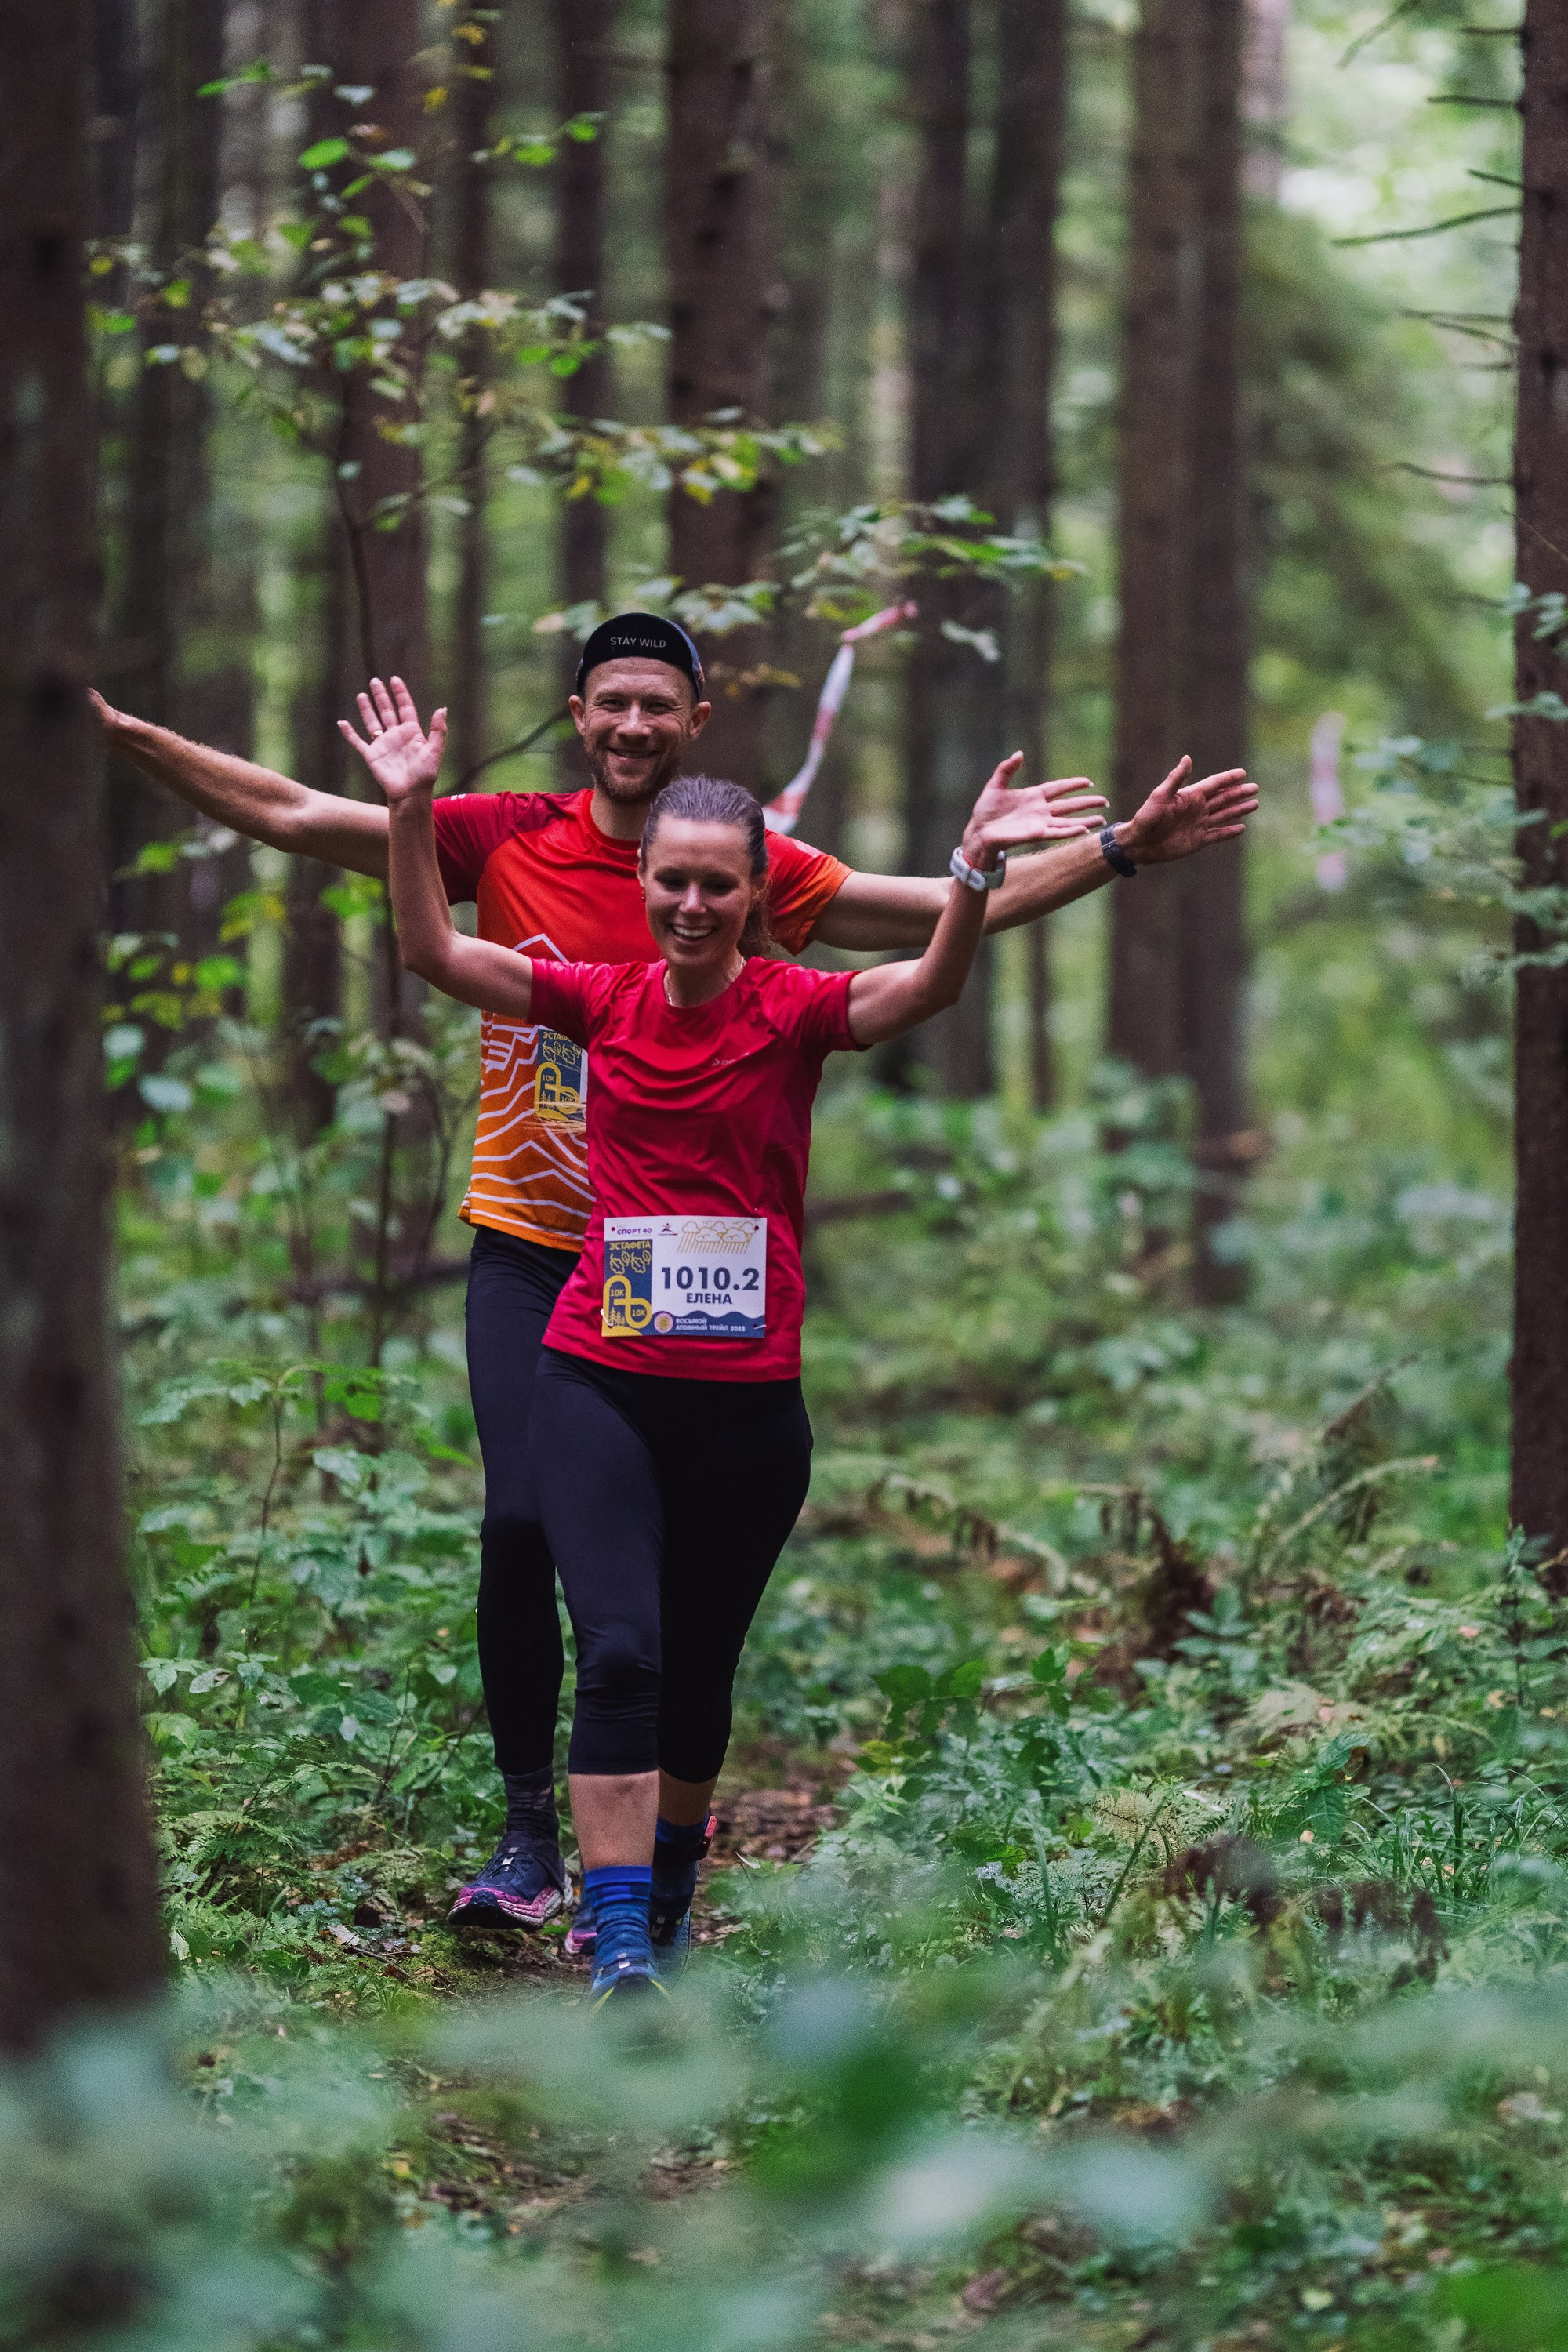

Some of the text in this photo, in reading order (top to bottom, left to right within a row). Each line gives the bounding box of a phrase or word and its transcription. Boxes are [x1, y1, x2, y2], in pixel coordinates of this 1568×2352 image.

[610, 637, 666, 648] STAY WILD
[609, 1241, 652, 1250] ЭСТАФЕТА
[662, 1266, 760, 1290] 1010.2
[686, 1293, 732, 1305] ЕЛЕНА
